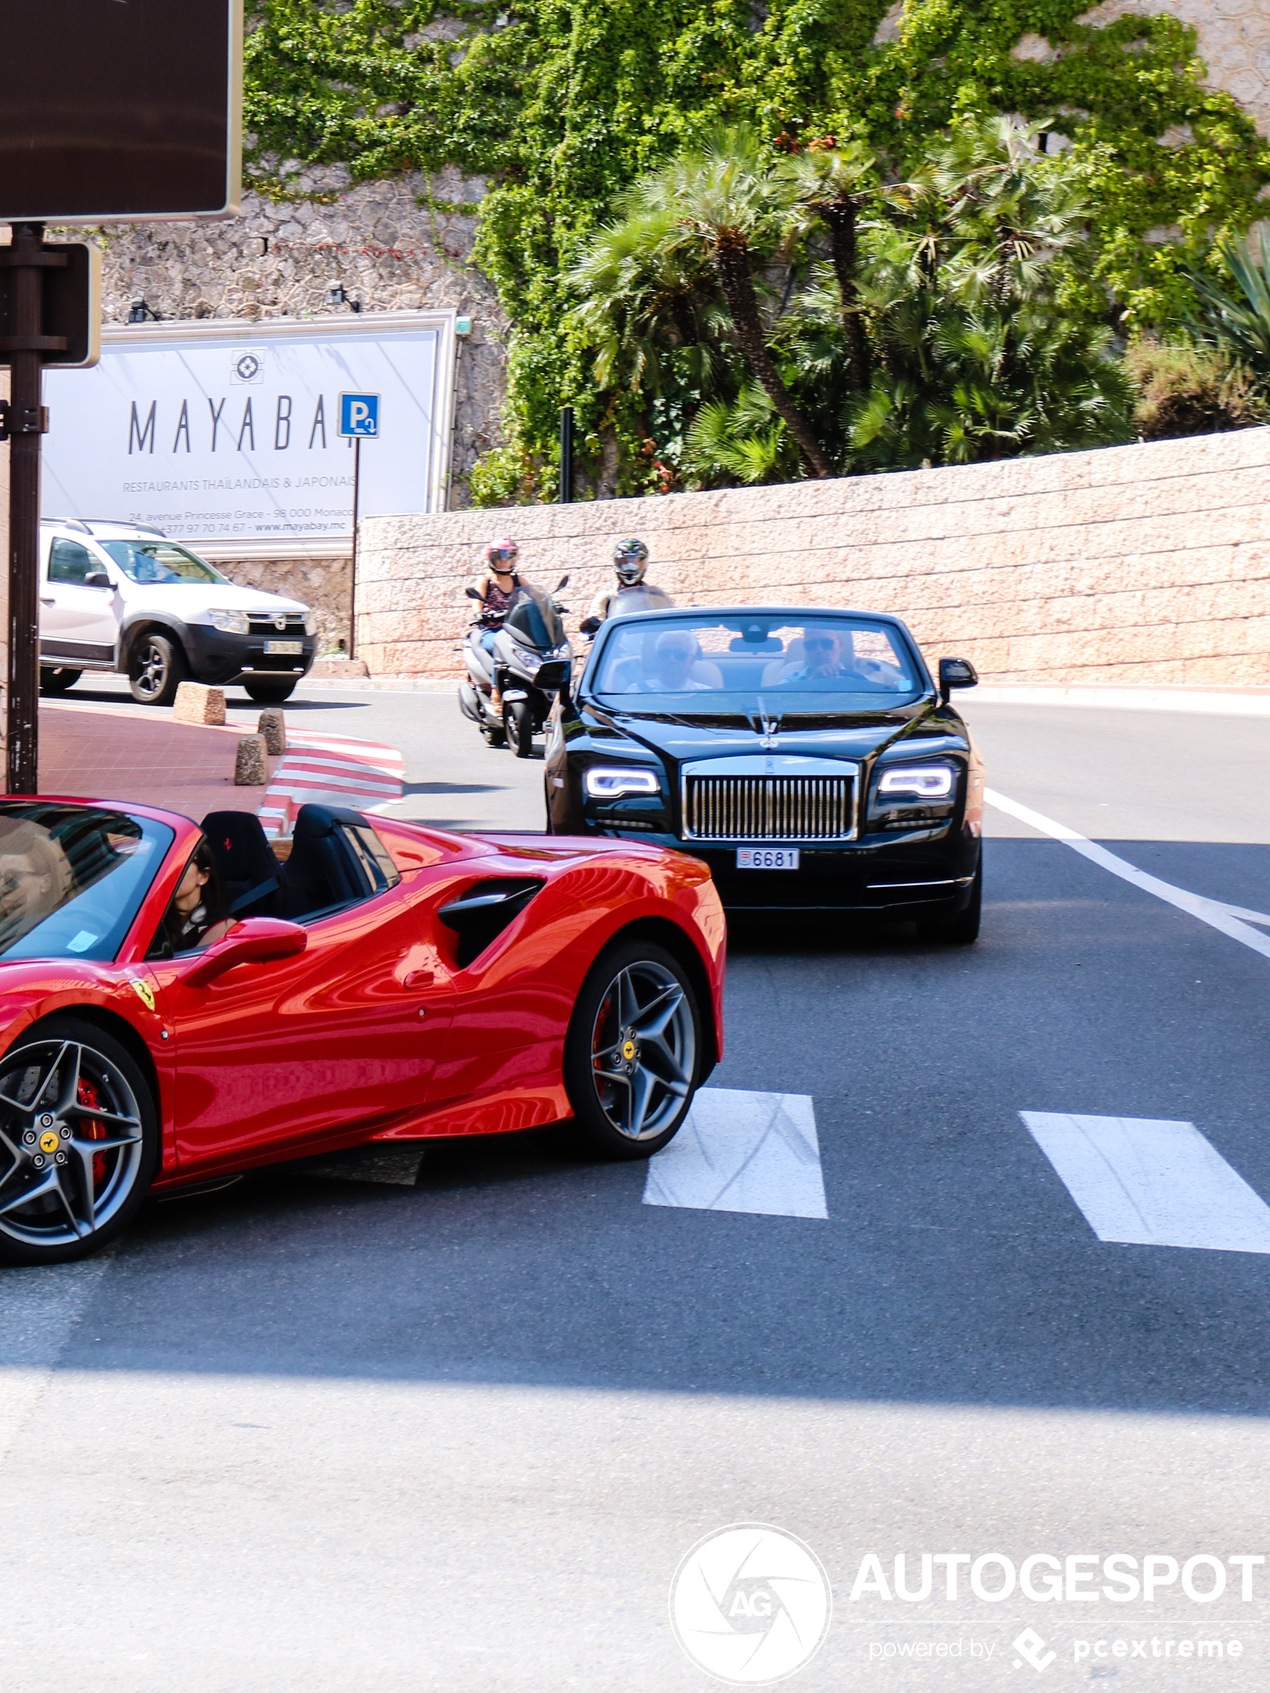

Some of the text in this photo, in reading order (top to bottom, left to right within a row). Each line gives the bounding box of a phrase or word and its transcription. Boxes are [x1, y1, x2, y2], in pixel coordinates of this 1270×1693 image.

[350, 401, 369, 428] P
[128, 394, 352, 454] MAYABA
[123, 476, 356, 492] RESTAURANTS THAÏLANDAIS & JAPONAIS
[129, 513, 143, 522] 24,
[146, 513, 182, 521] avenue
[185, 511, 232, 520] Princesse
[234, 510, 264, 519] Grace
[273, 509, 286, 518] 98
[290, 508, 311, 517] 000
[314, 508, 354, 517] Monaco
[187, 524, 199, 533] 97
[202, 524, 215, 532] 70
[218, 524, 229, 532] 74
[232, 523, 246, 532] 67
[255, 521, 346, 532] www.mayabay.mc
[753, 851, 794, 867] 6681
